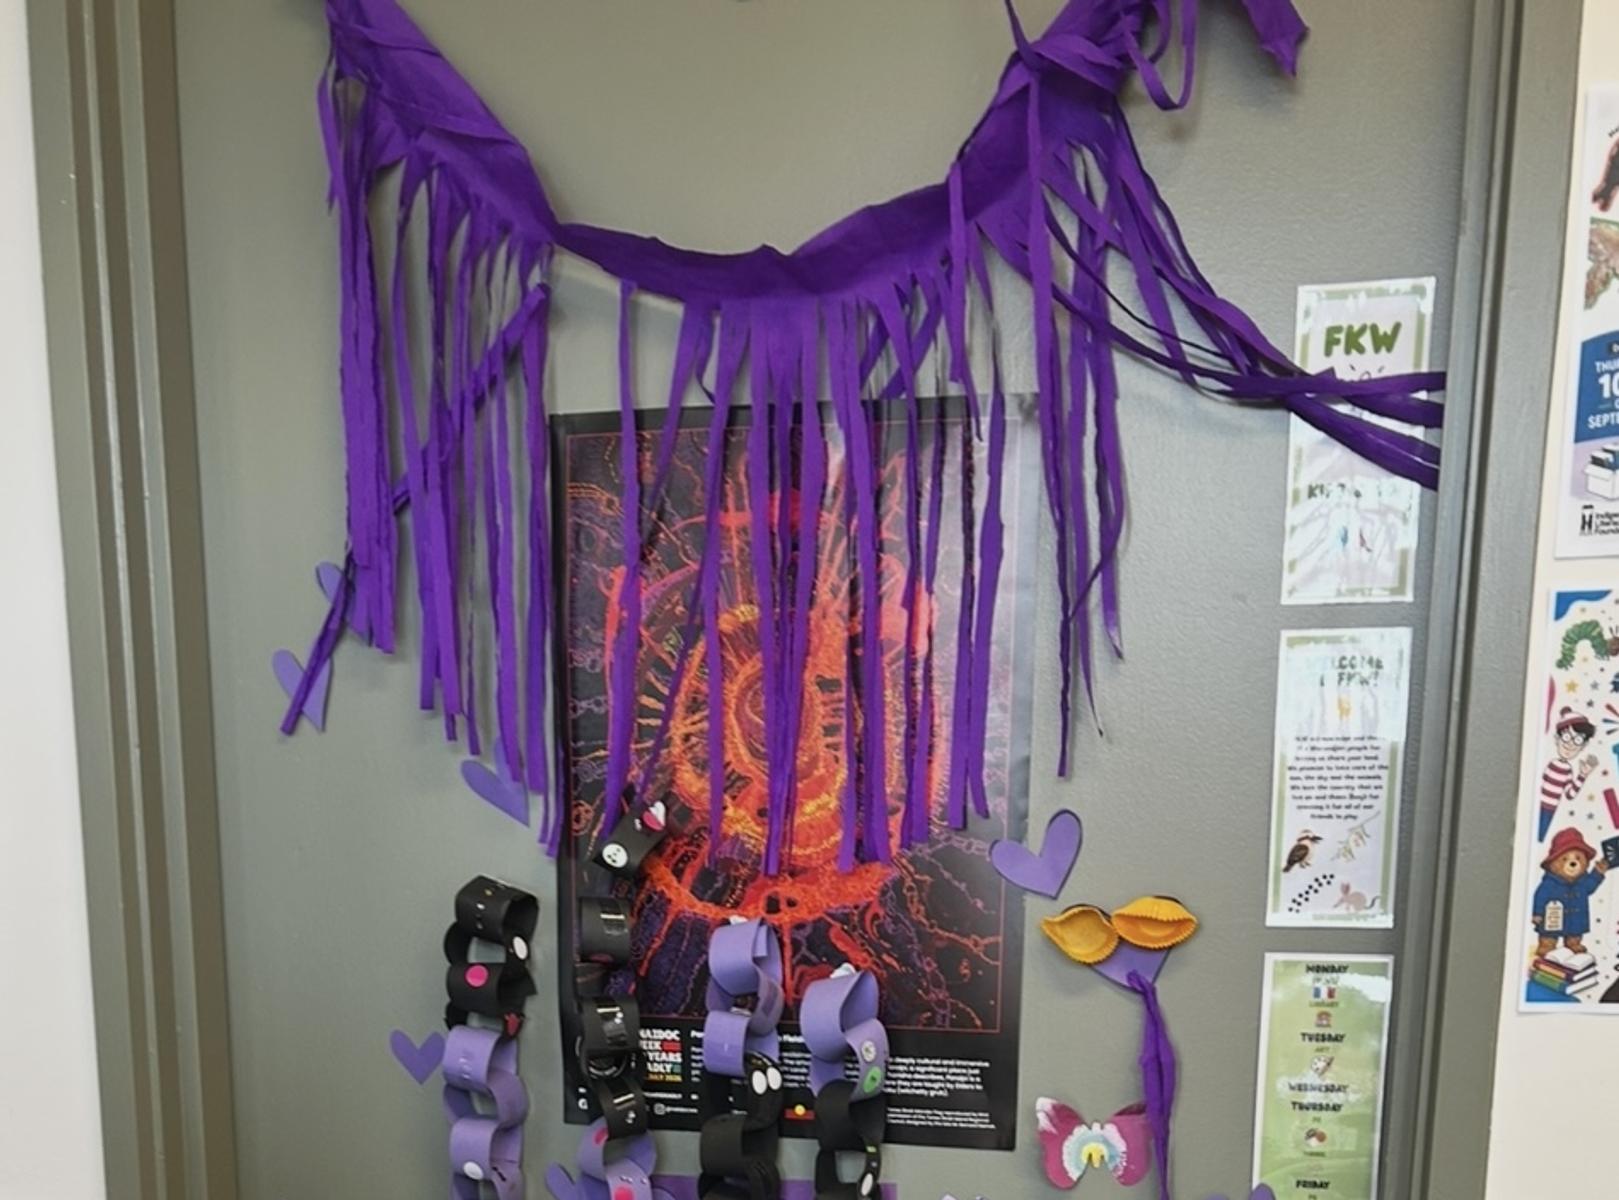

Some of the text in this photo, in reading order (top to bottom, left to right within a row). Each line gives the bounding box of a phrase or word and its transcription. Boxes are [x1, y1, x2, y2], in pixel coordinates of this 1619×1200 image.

[1324, 321, 1402, 357] FKW
[1306, 964, 1349, 974] MONDAY
[1300, 1032, 1346, 1043] TUESDAY
[646, 1051, 682, 1063] YEARS
[1288, 1081, 1349, 1094] WEDNESDAY
[1291, 1101, 1343, 1112] THURSDAY
[1296, 1180, 1331, 1189] FRIDAY
